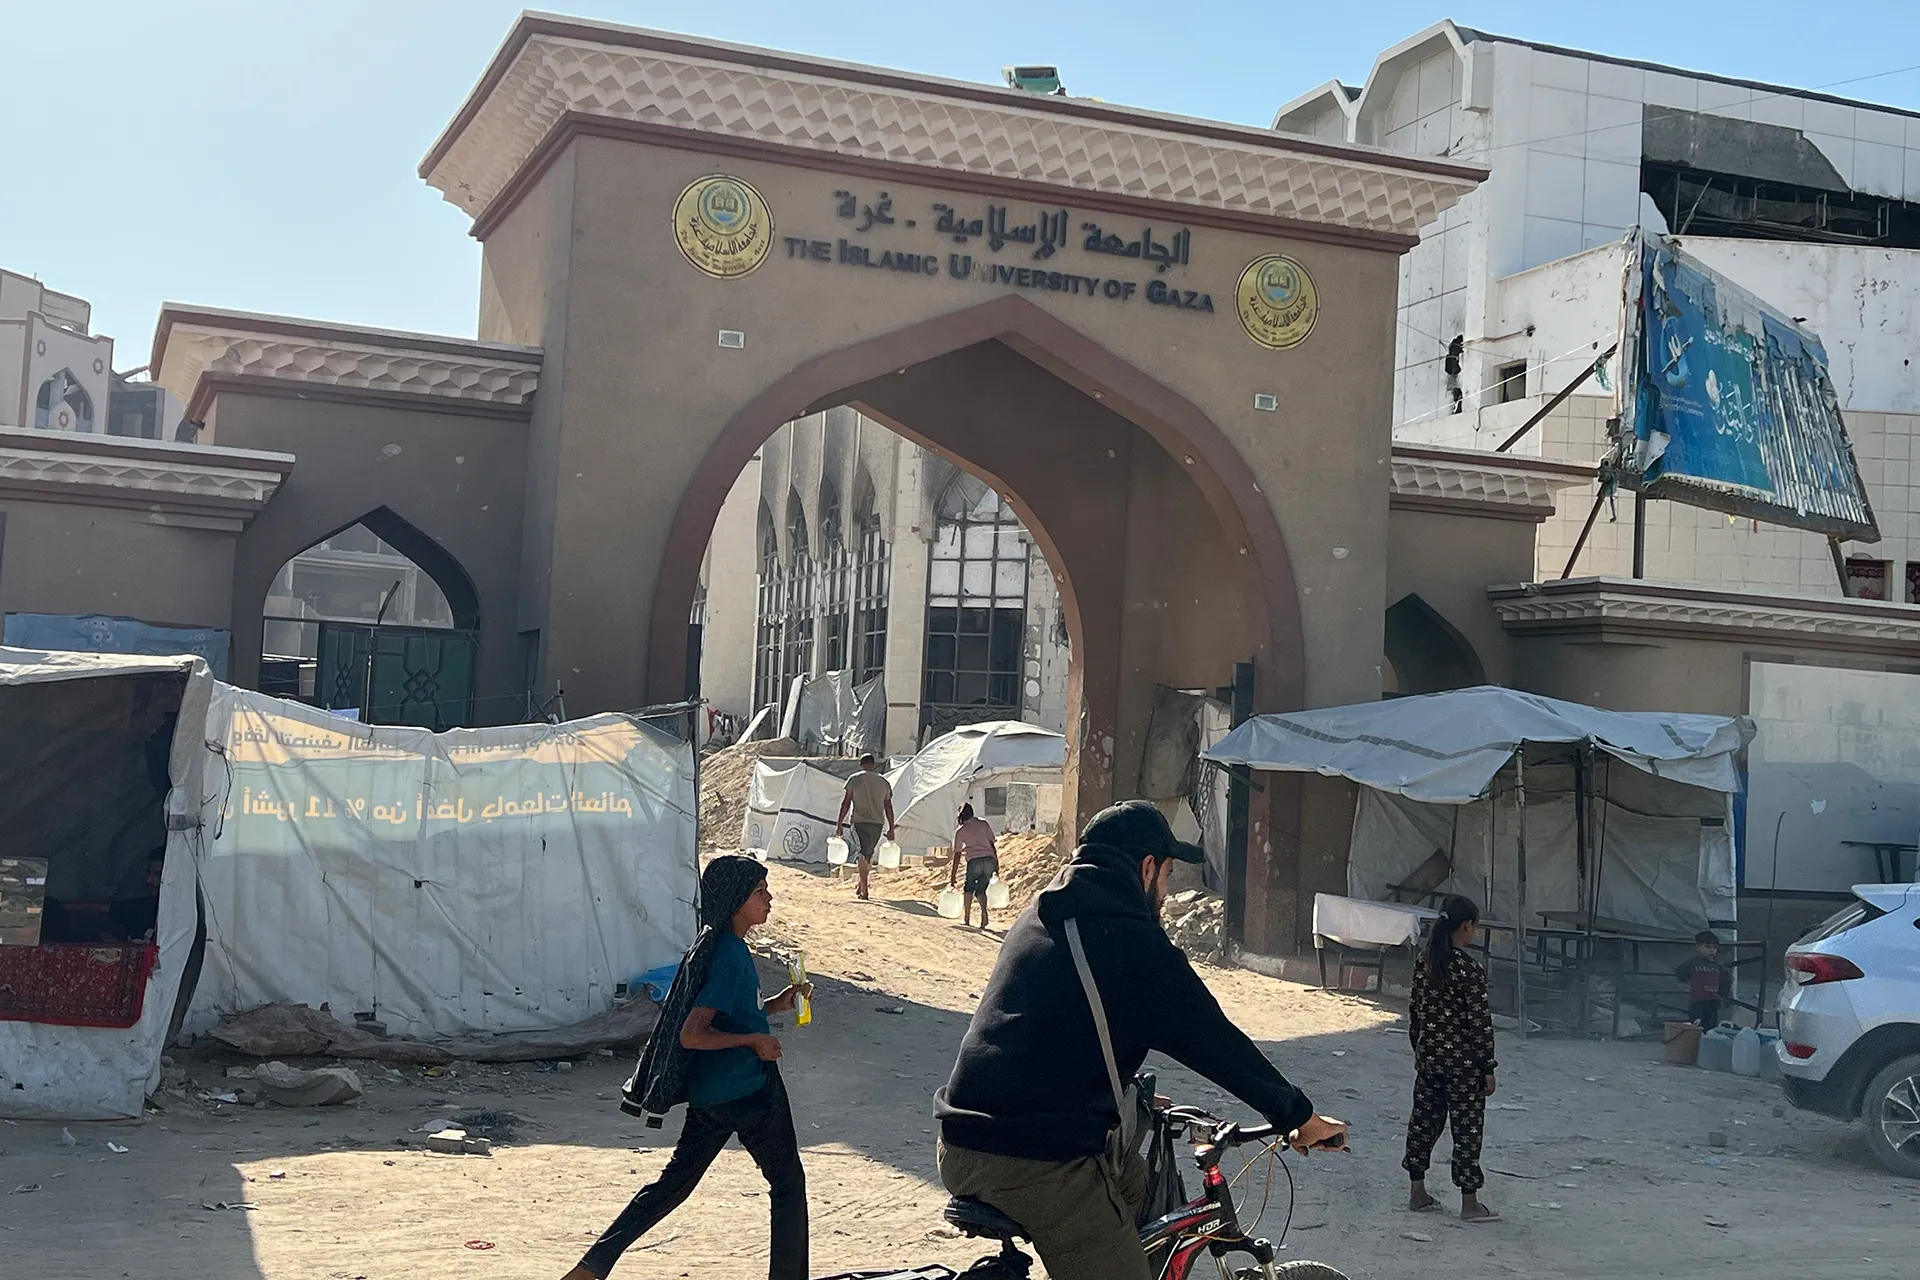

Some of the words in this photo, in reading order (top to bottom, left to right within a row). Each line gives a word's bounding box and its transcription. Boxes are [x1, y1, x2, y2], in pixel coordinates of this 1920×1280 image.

[833, 190, 895, 232] غزة
[932, 203, 1069, 260] الإسلامية
[1081, 222, 1191, 273] الجامعة
[783, 236, 832, 263] THE
[1102, 279, 1137, 301] OF
[1144, 279, 1215, 314] GAZA
